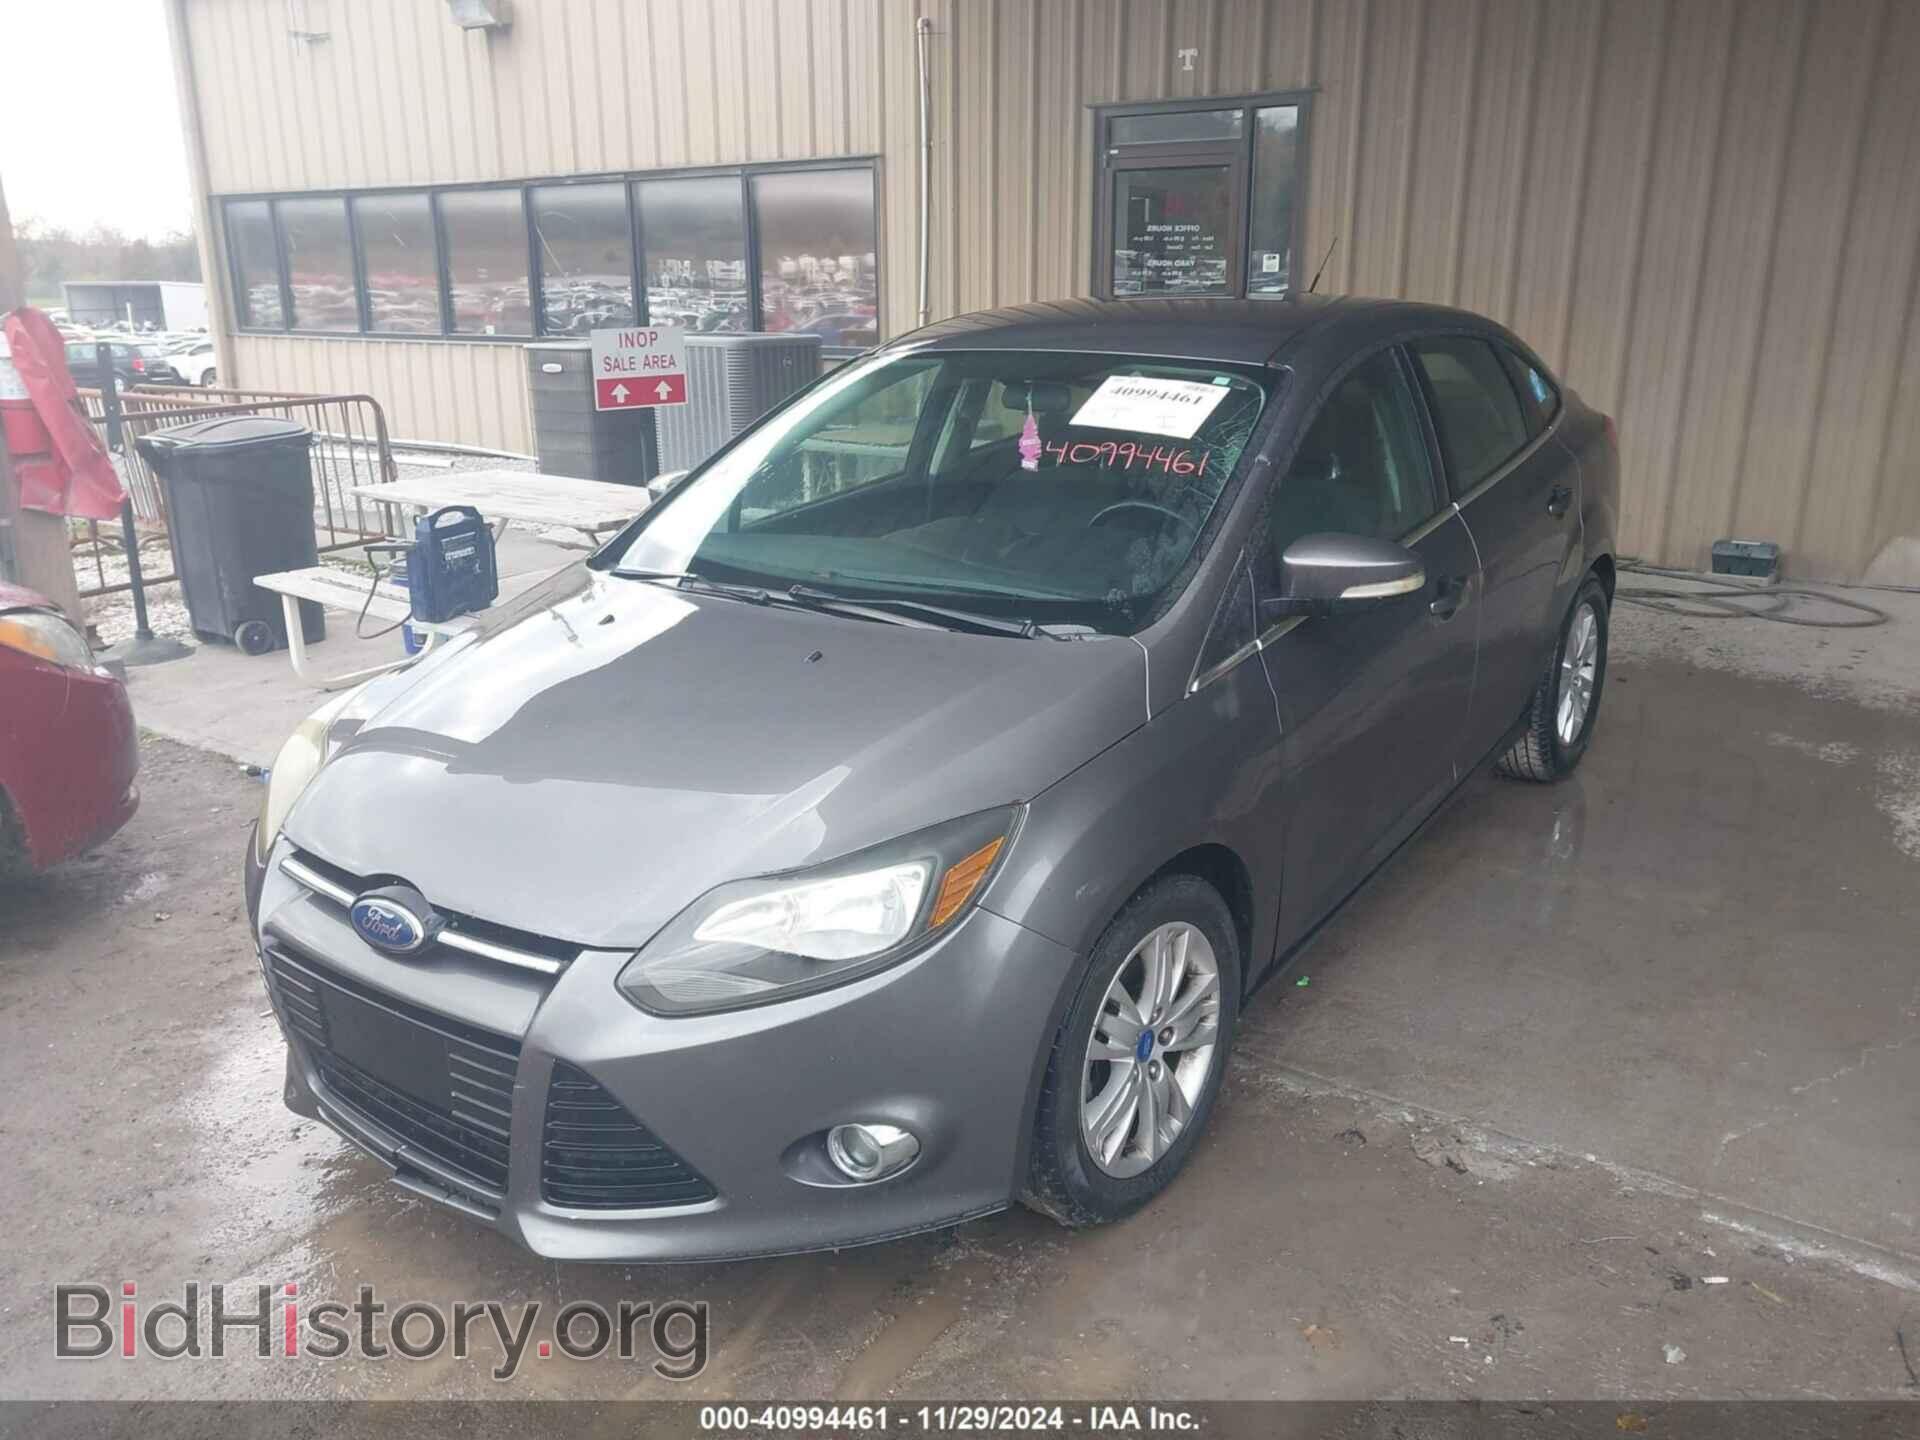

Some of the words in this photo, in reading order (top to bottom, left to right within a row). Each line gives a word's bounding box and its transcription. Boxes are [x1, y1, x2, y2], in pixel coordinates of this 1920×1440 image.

[618, 331, 658, 349] INOP
[603, 355, 637, 373] SALE
[642, 354, 677, 370] AREA
[1109, 385, 1203, 406] 40994461
[1045, 441, 1210, 476] 40994461
[362, 906, 403, 941] Ford
